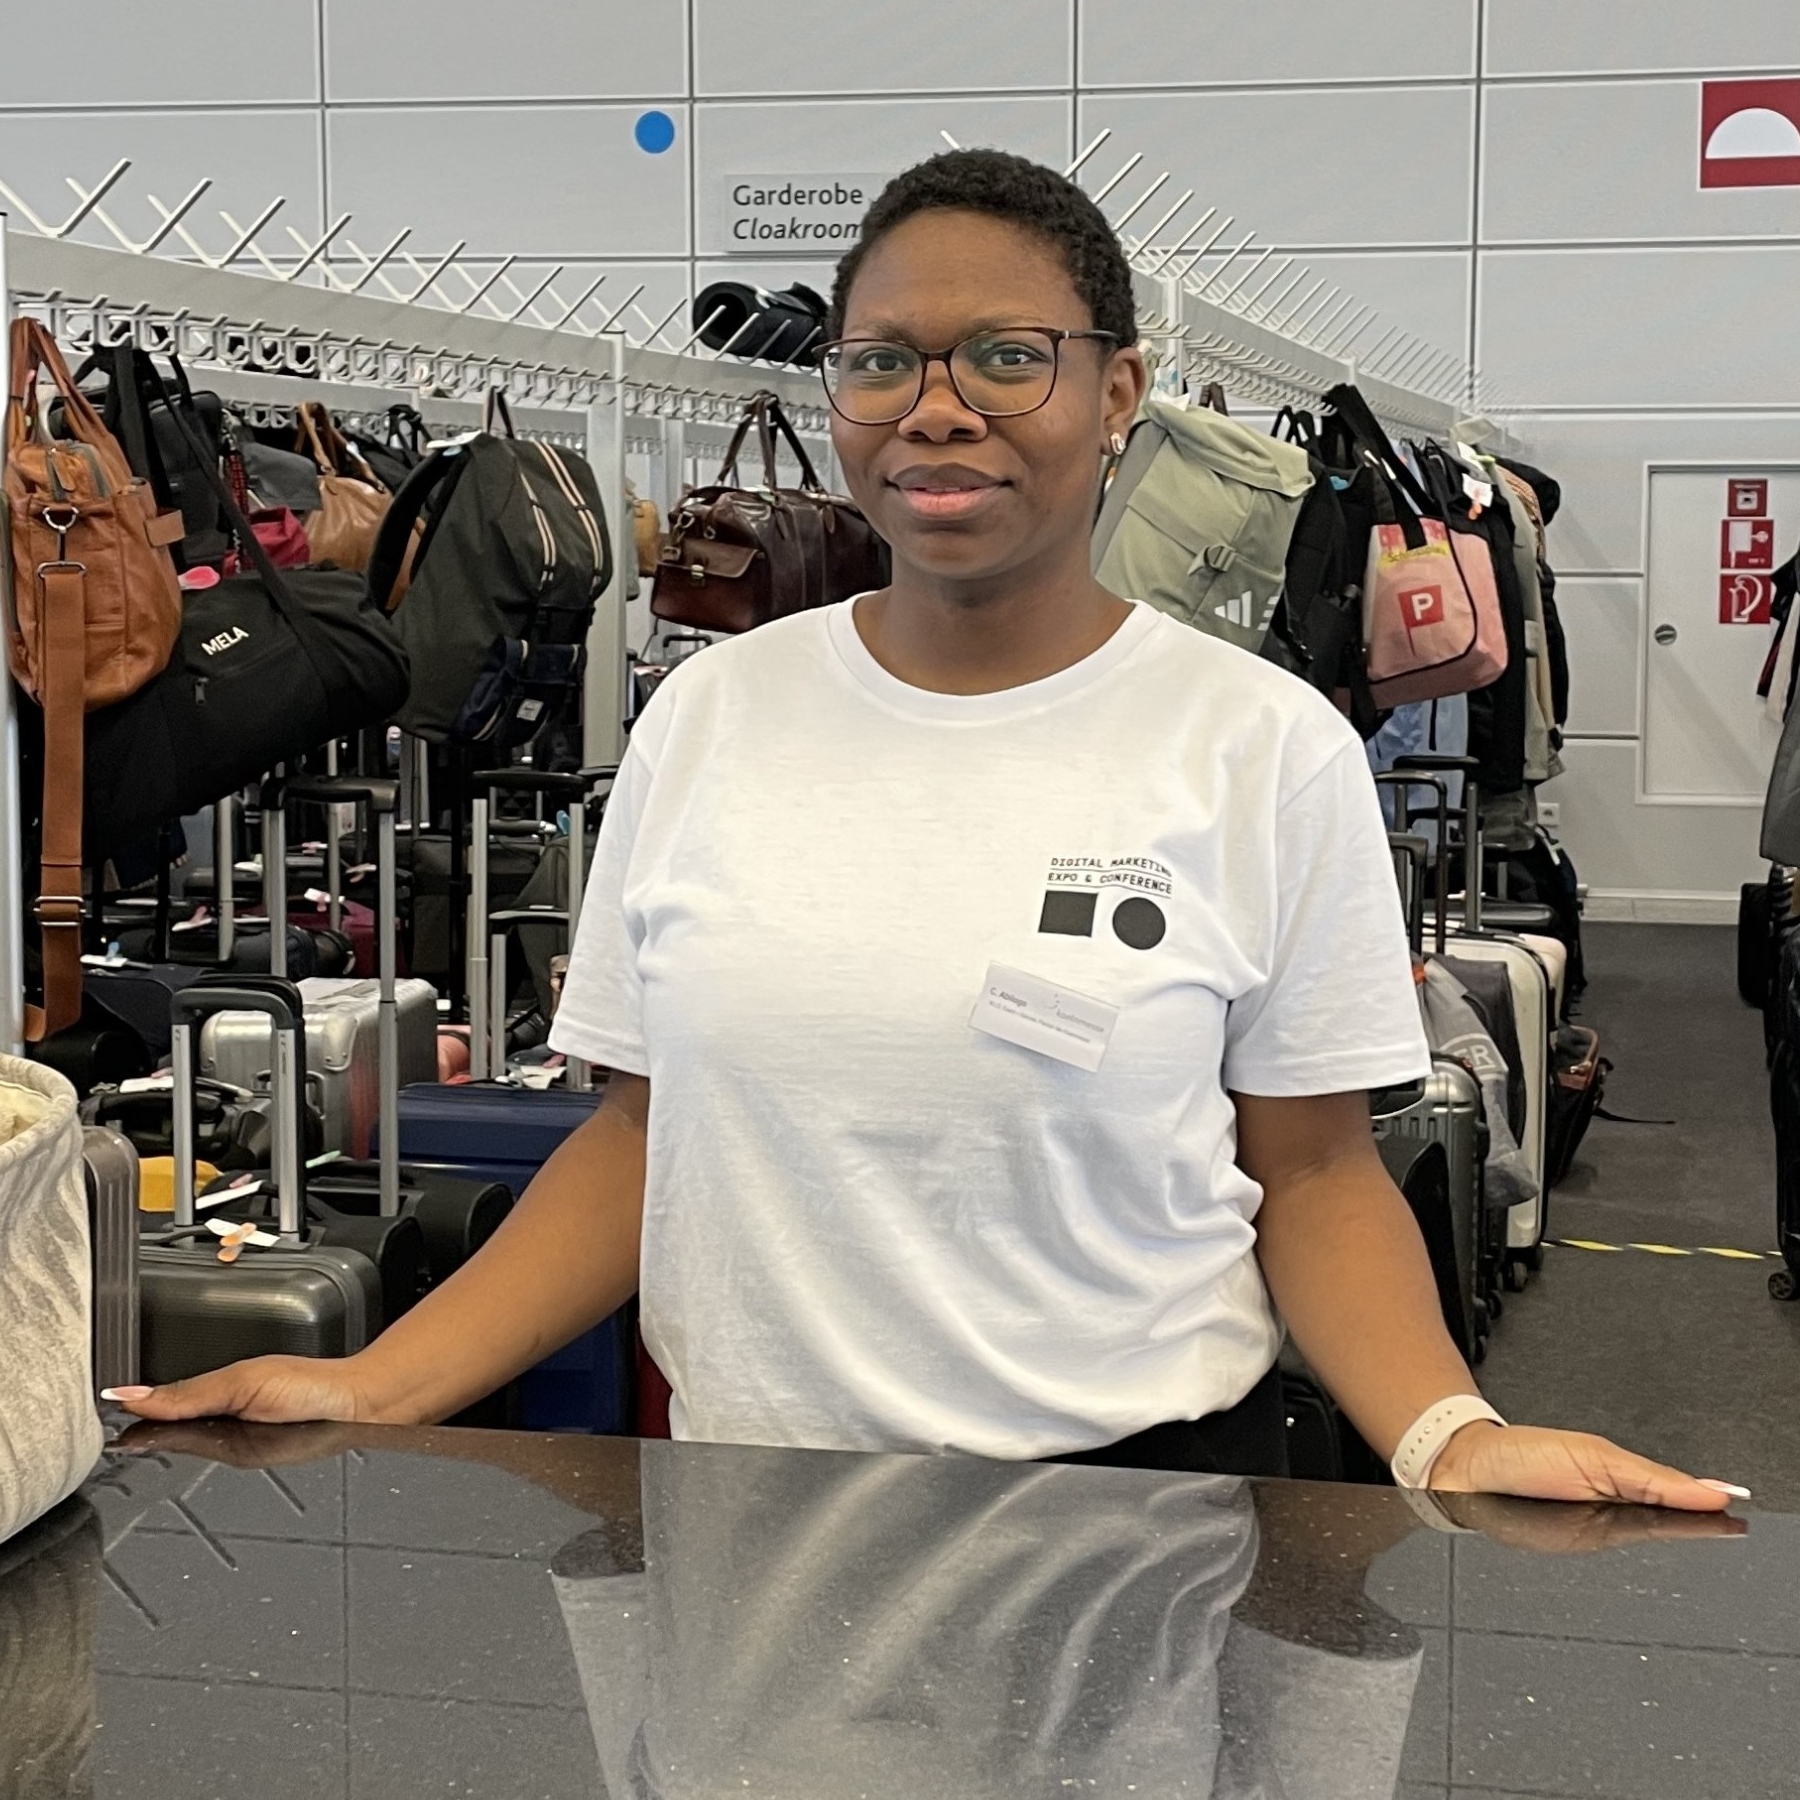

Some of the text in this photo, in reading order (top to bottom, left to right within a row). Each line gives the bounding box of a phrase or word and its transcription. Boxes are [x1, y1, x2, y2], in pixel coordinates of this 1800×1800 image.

[732, 182, 863, 206] Garderobe
[1411, 593, 1434, 621] P
[201, 626, 250, 656] MELA
[1050, 857, 1103, 868] DIGITAL
[1047, 872, 1172, 895] EXPO & CONFERENCE
